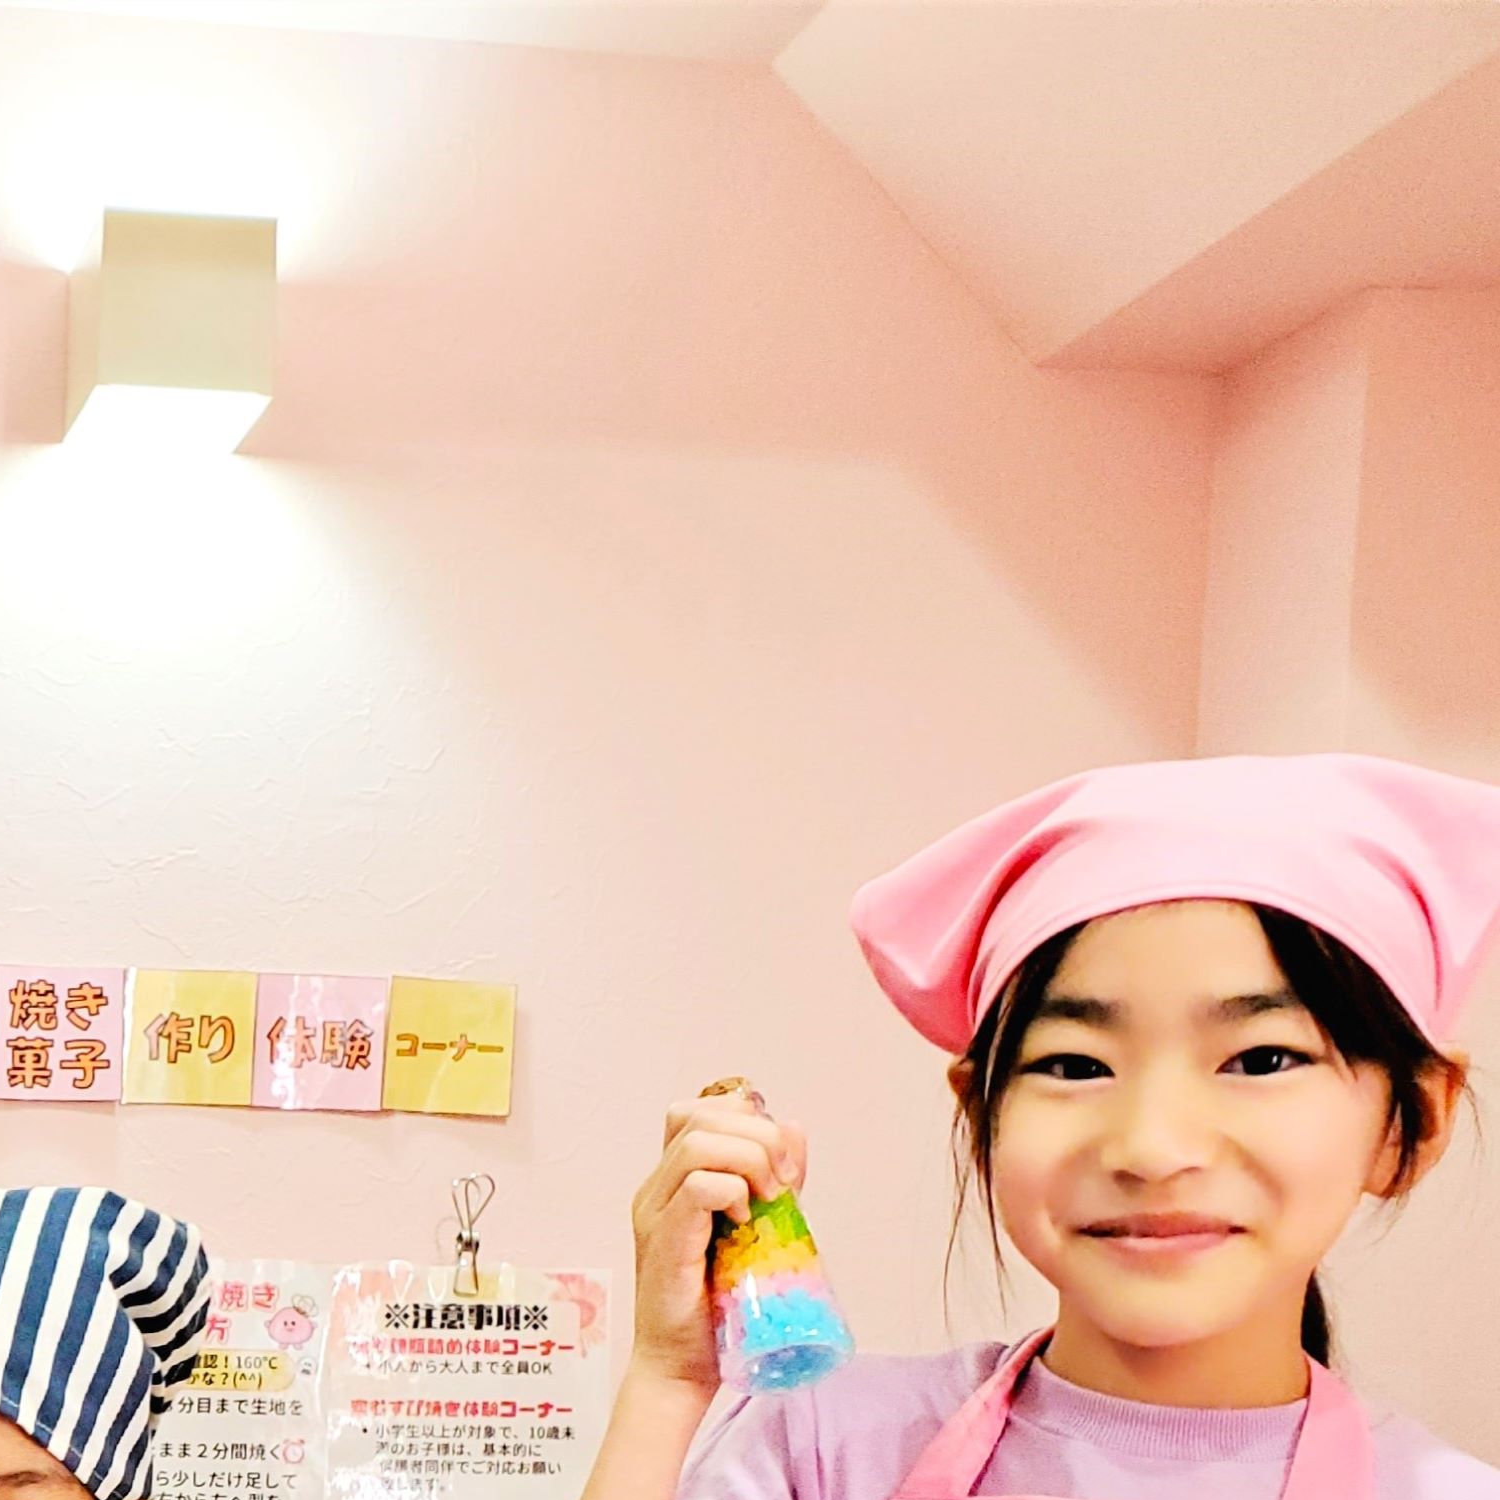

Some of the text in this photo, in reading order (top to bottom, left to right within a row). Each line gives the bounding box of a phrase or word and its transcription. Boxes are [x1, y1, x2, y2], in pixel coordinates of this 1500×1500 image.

[9, 979, 108, 1031] 焼き
[6, 1037, 110, 1089] 菓子
[143, 1012, 504, 1070] 作り 体験 コーナー
[220, 1282, 277, 1309] 焼き
[167, 1397, 303, 1416] 分目まで生地を
